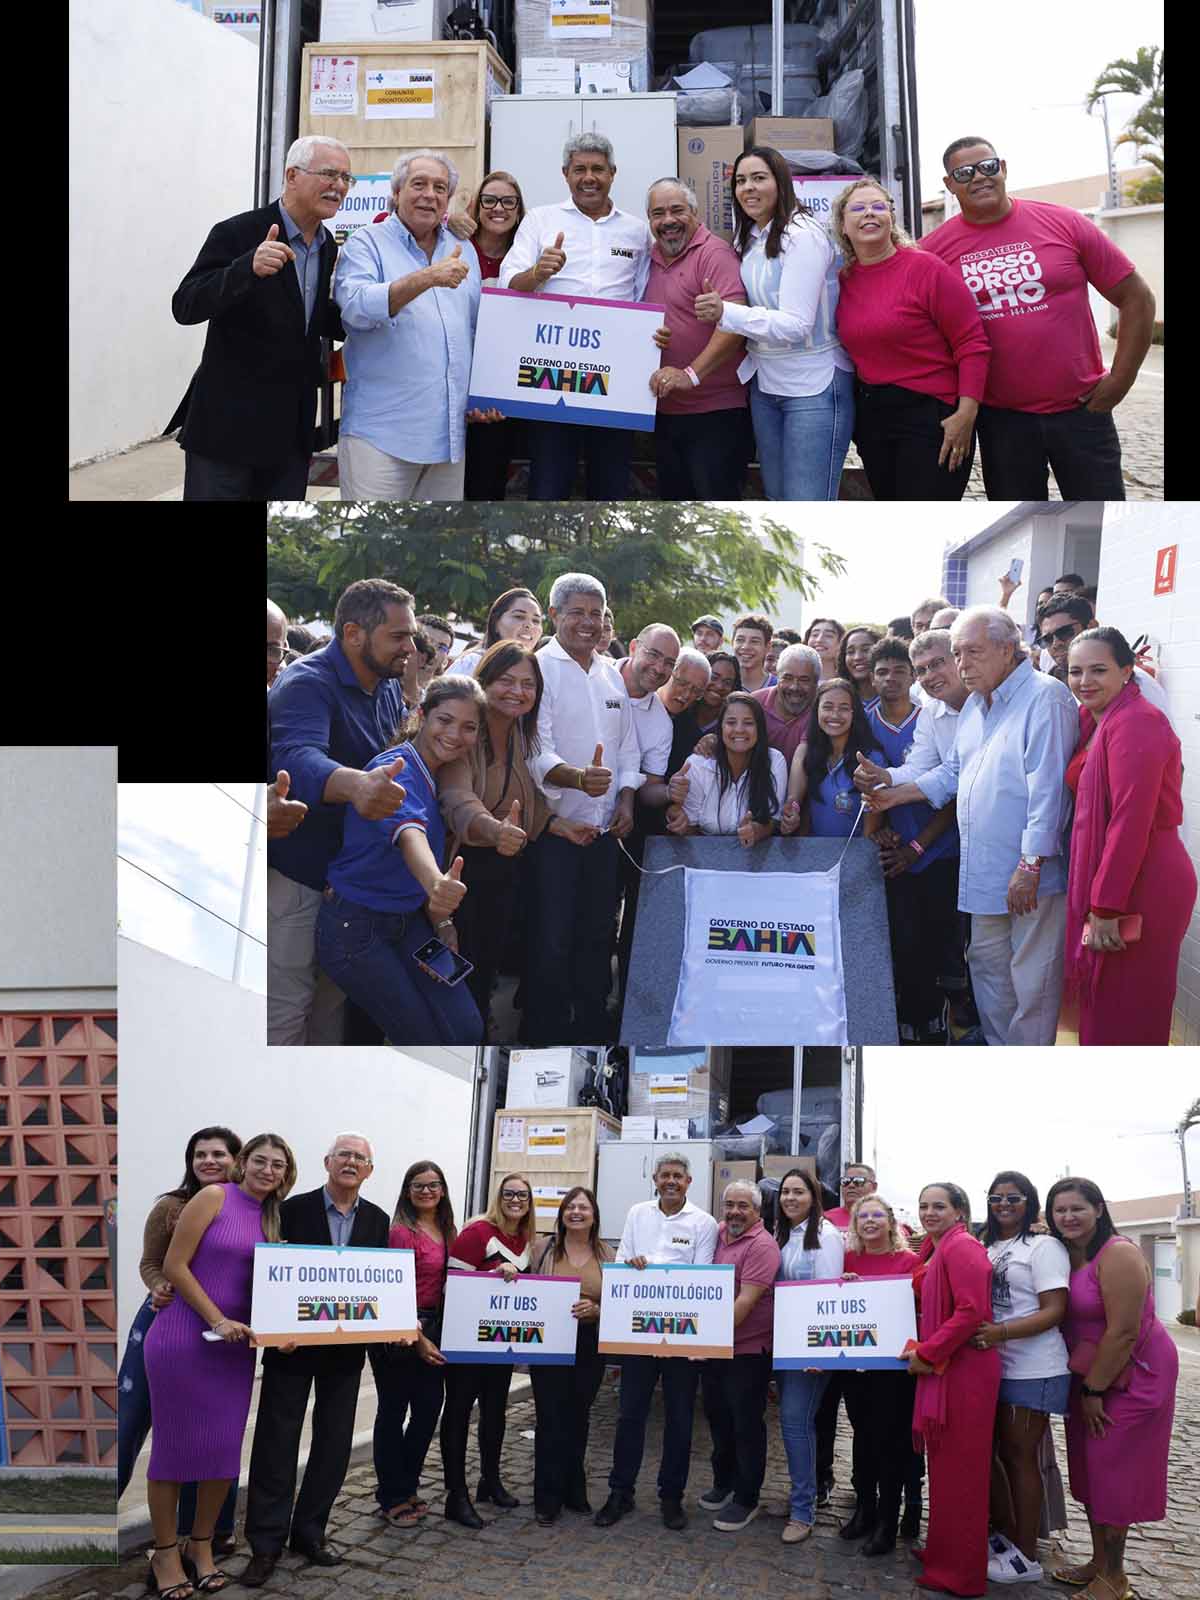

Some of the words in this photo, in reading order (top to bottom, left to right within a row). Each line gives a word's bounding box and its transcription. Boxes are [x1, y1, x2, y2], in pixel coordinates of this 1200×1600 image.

[960, 249, 996, 263] NOSSA
[996, 241, 1032, 257] TERRA
[961, 250, 1036, 278] NOSSO
[965, 262, 1043, 293] ORGU
[1026, 303, 1049, 313] Anos
[535, 323, 563, 345] KIT
[568, 327, 601, 349] UBS
[520, 356, 561, 368] GOVERNO
[563, 360, 577, 370] DO
[579, 362, 611, 373] ESTADO
[517, 364, 609, 396] BAHIA
[709, 918, 758, 929] GOVERNO
[760, 921, 775, 929] DO
[777, 922, 815, 933] ESTADO
[707, 927, 816, 956] BAHIA
[796, 963, 815, 971] GENTE
[268, 1265, 294, 1282] KIT
[299, 1263, 403, 1284] ODONTOLÓGICO
[610, 1283, 630, 1299] KIT
[633, 1282, 723, 1301] ODONTOLÓGICO
[297, 1302, 379, 1321] BAHIA
[490, 1295, 510, 1310] KIT
[513, 1296, 537, 1311] UBS
[816, 1300, 836, 1316] KIT
[841, 1299, 867, 1314] UBS
[521, 1320, 545, 1328] ESTADO
[631, 1316, 698, 1335] BAHIA
[477, 1326, 544, 1343] BAHIA
[807, 1330, 878, 1347] BAHIA
